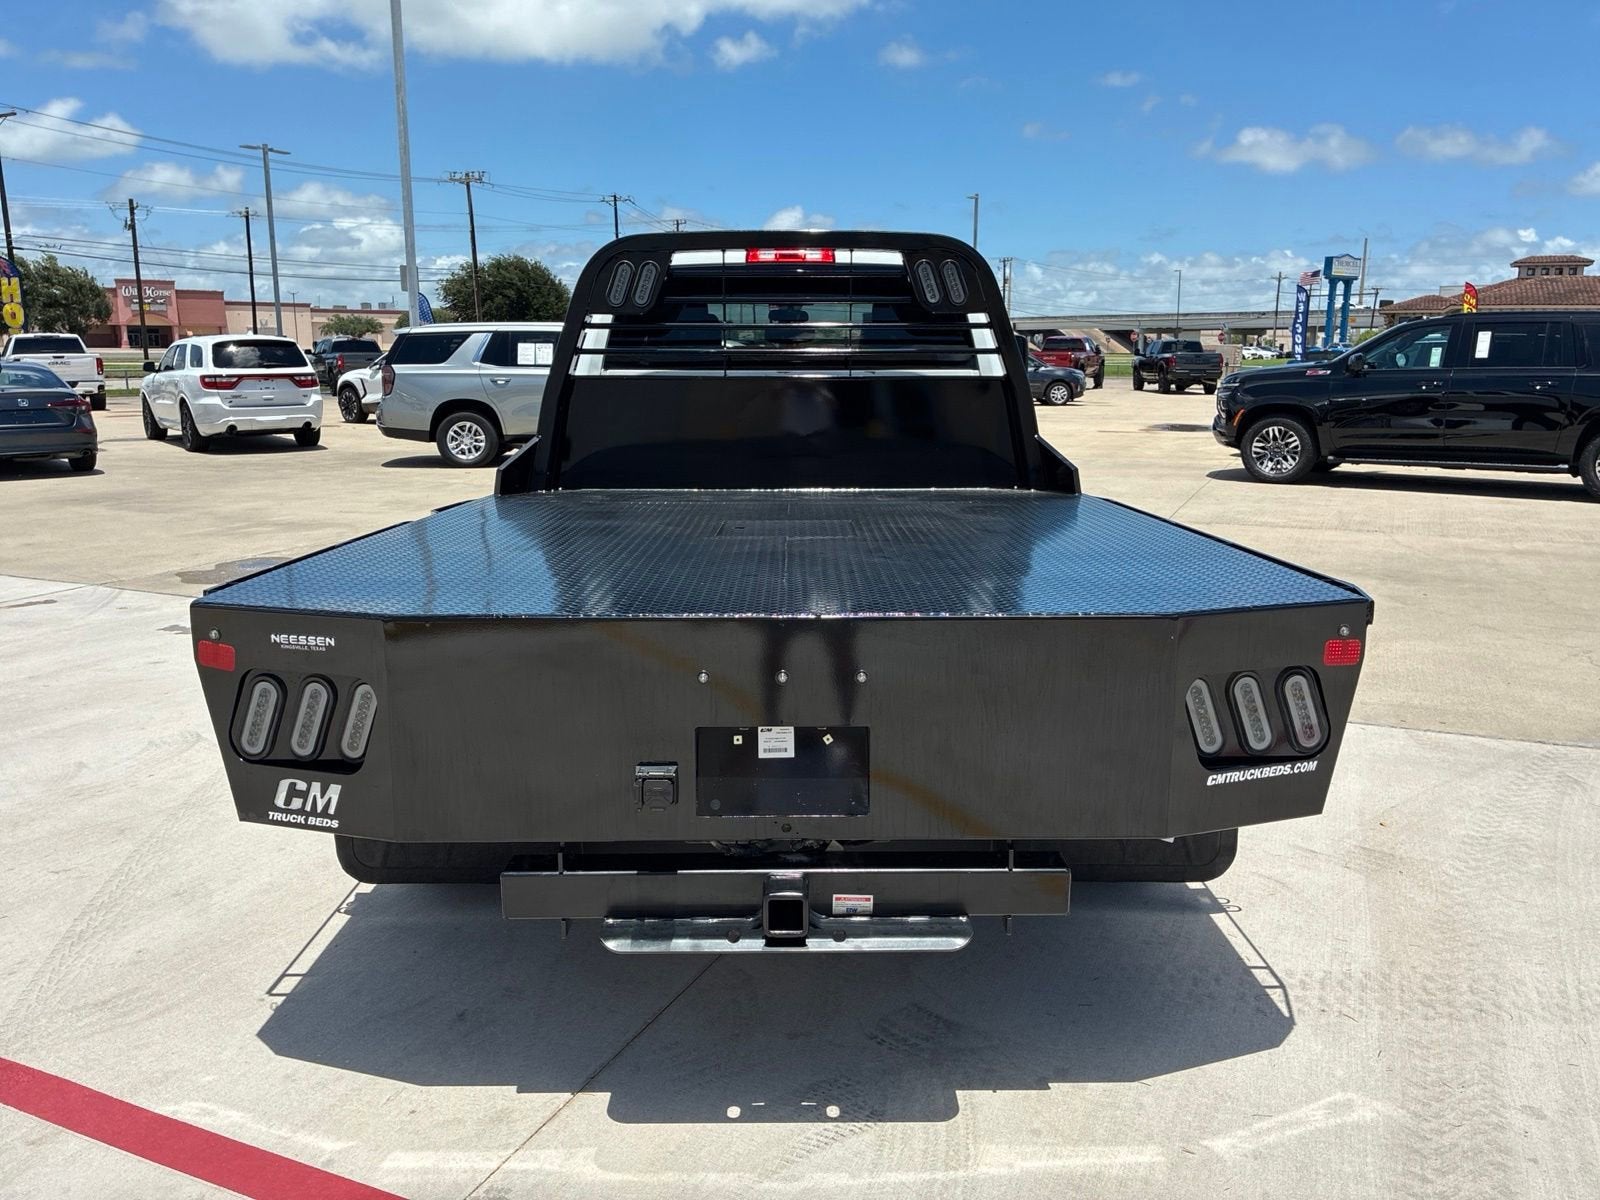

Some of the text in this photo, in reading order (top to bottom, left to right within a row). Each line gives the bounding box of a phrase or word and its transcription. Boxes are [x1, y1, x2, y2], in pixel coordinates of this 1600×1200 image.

[121, 286, 171, 298] Wil Horse
[271, 634, 335, 647] NEESSEN
[1206, 760, 1318, 786] CMTRUCKBEDS.COM
[274, 778, 342, 815] CM
[267, 811, 340, 829] TRUCK BEDS
